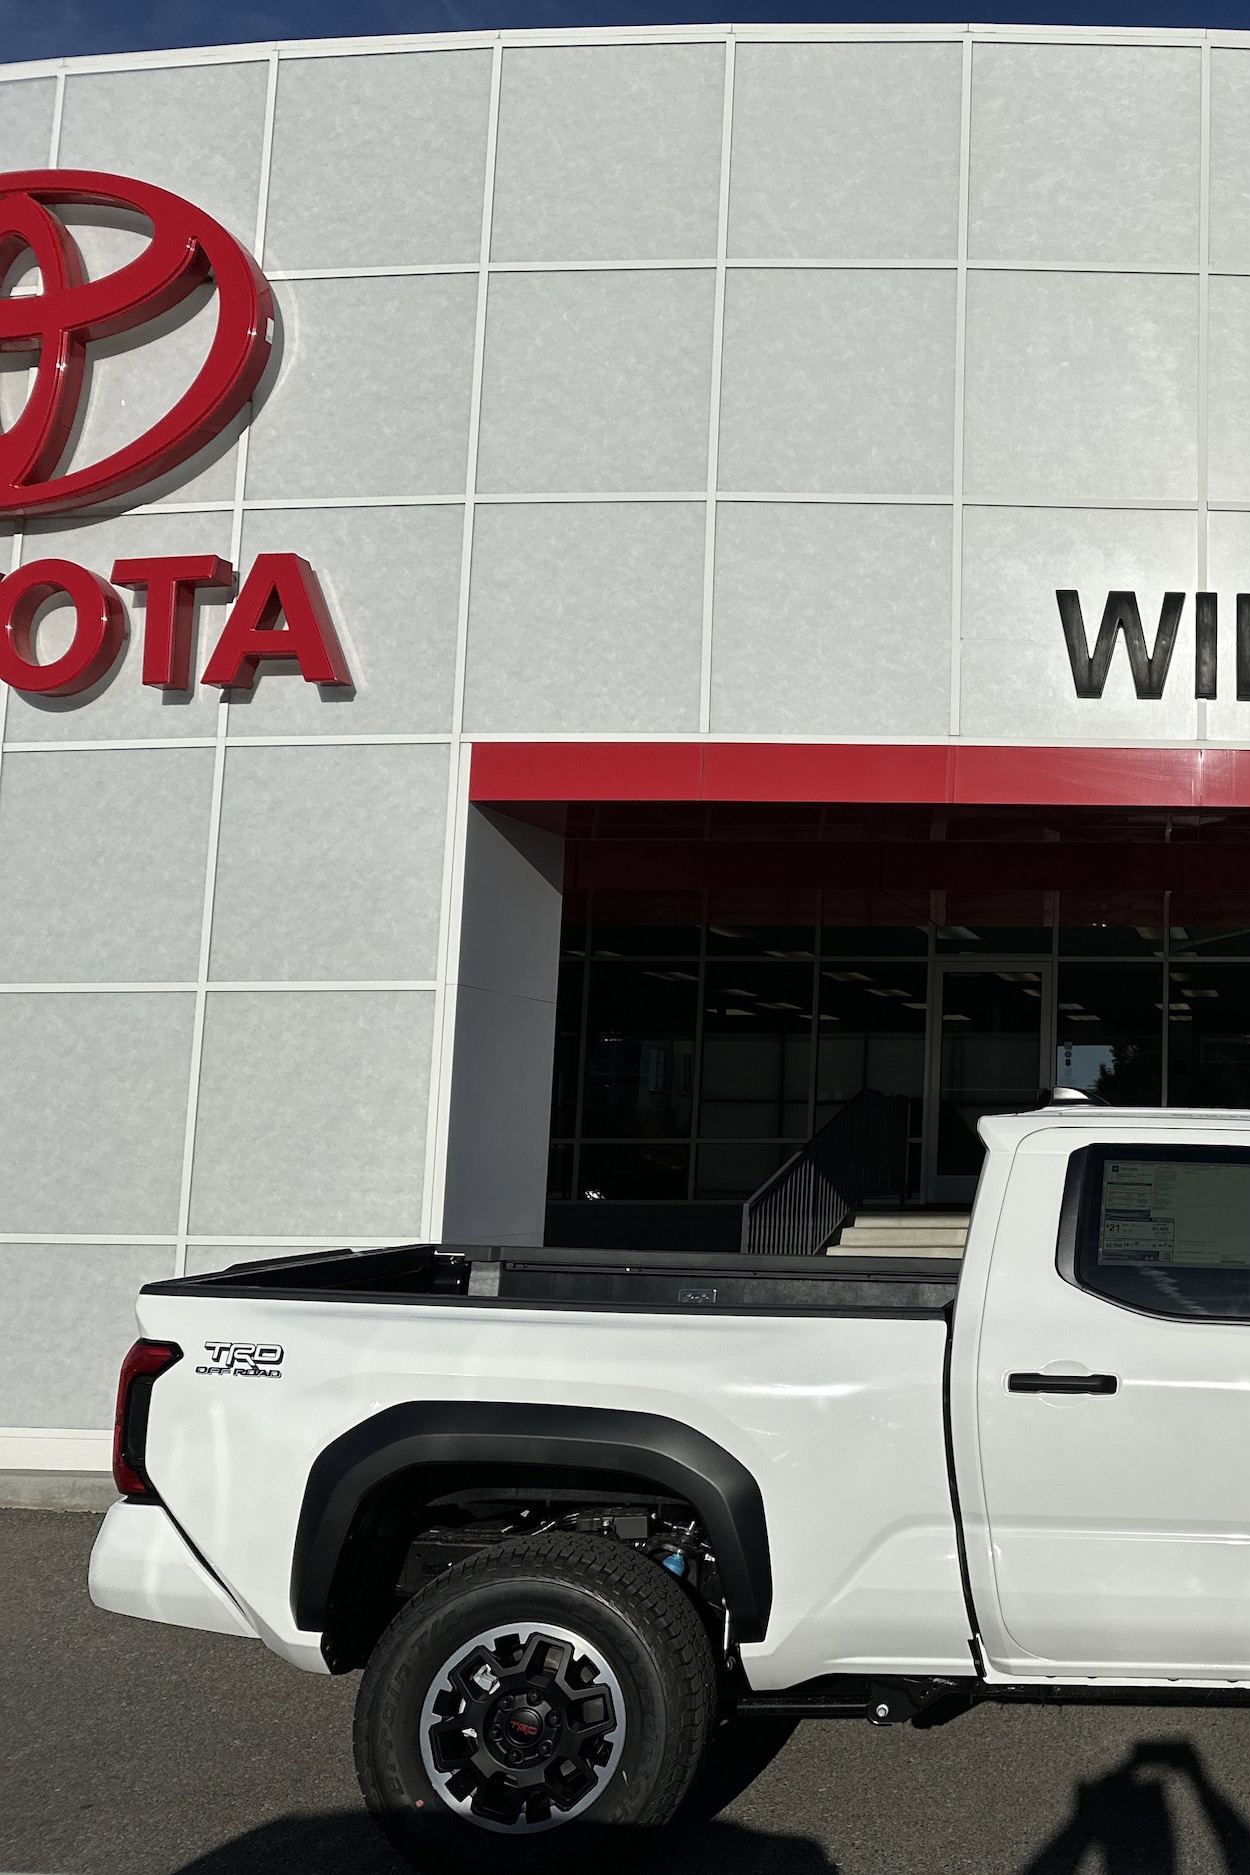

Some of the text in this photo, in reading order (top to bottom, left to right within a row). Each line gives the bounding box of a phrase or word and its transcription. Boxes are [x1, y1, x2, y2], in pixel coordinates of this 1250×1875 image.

[0, 553, 352, 697] OTA
[1109, 1223, 1120, 1232] 21
[204, 1341, 284, 1369] TRD
[195, 1366, 282, 1378] OFF ROAD
[510, 1720, 538, 1736] TRD
